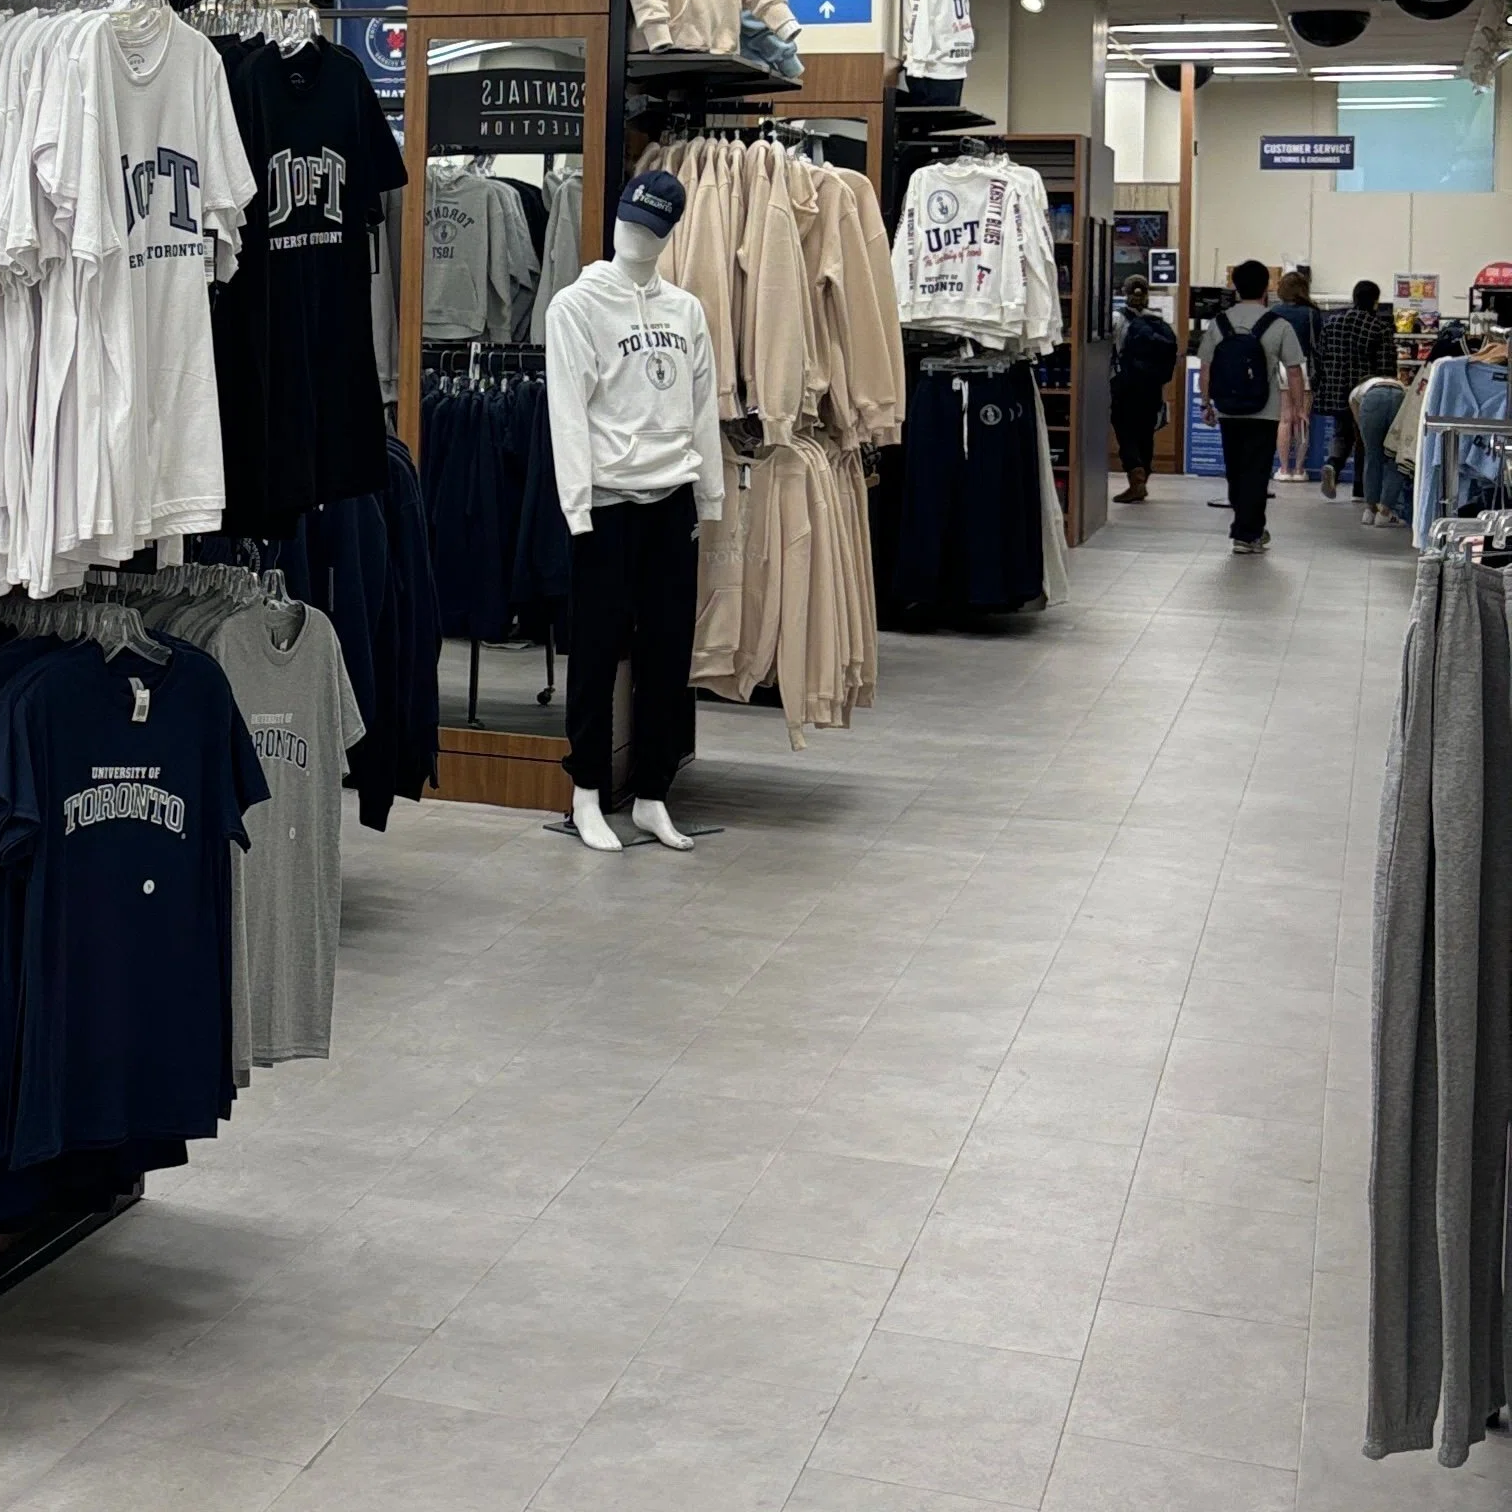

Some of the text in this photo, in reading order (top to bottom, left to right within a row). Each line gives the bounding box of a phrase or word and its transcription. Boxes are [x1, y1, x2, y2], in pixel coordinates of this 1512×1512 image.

[1264, 144, 1351, 154] CUSTOMER SERVICE
[146, 243, 203, 260] TORONTO
[252, 727, 308, 771] RONTO
[91, 767, 161, 779] UNIVERSITY OF
[63, 782, 185, 836] TORONTO
